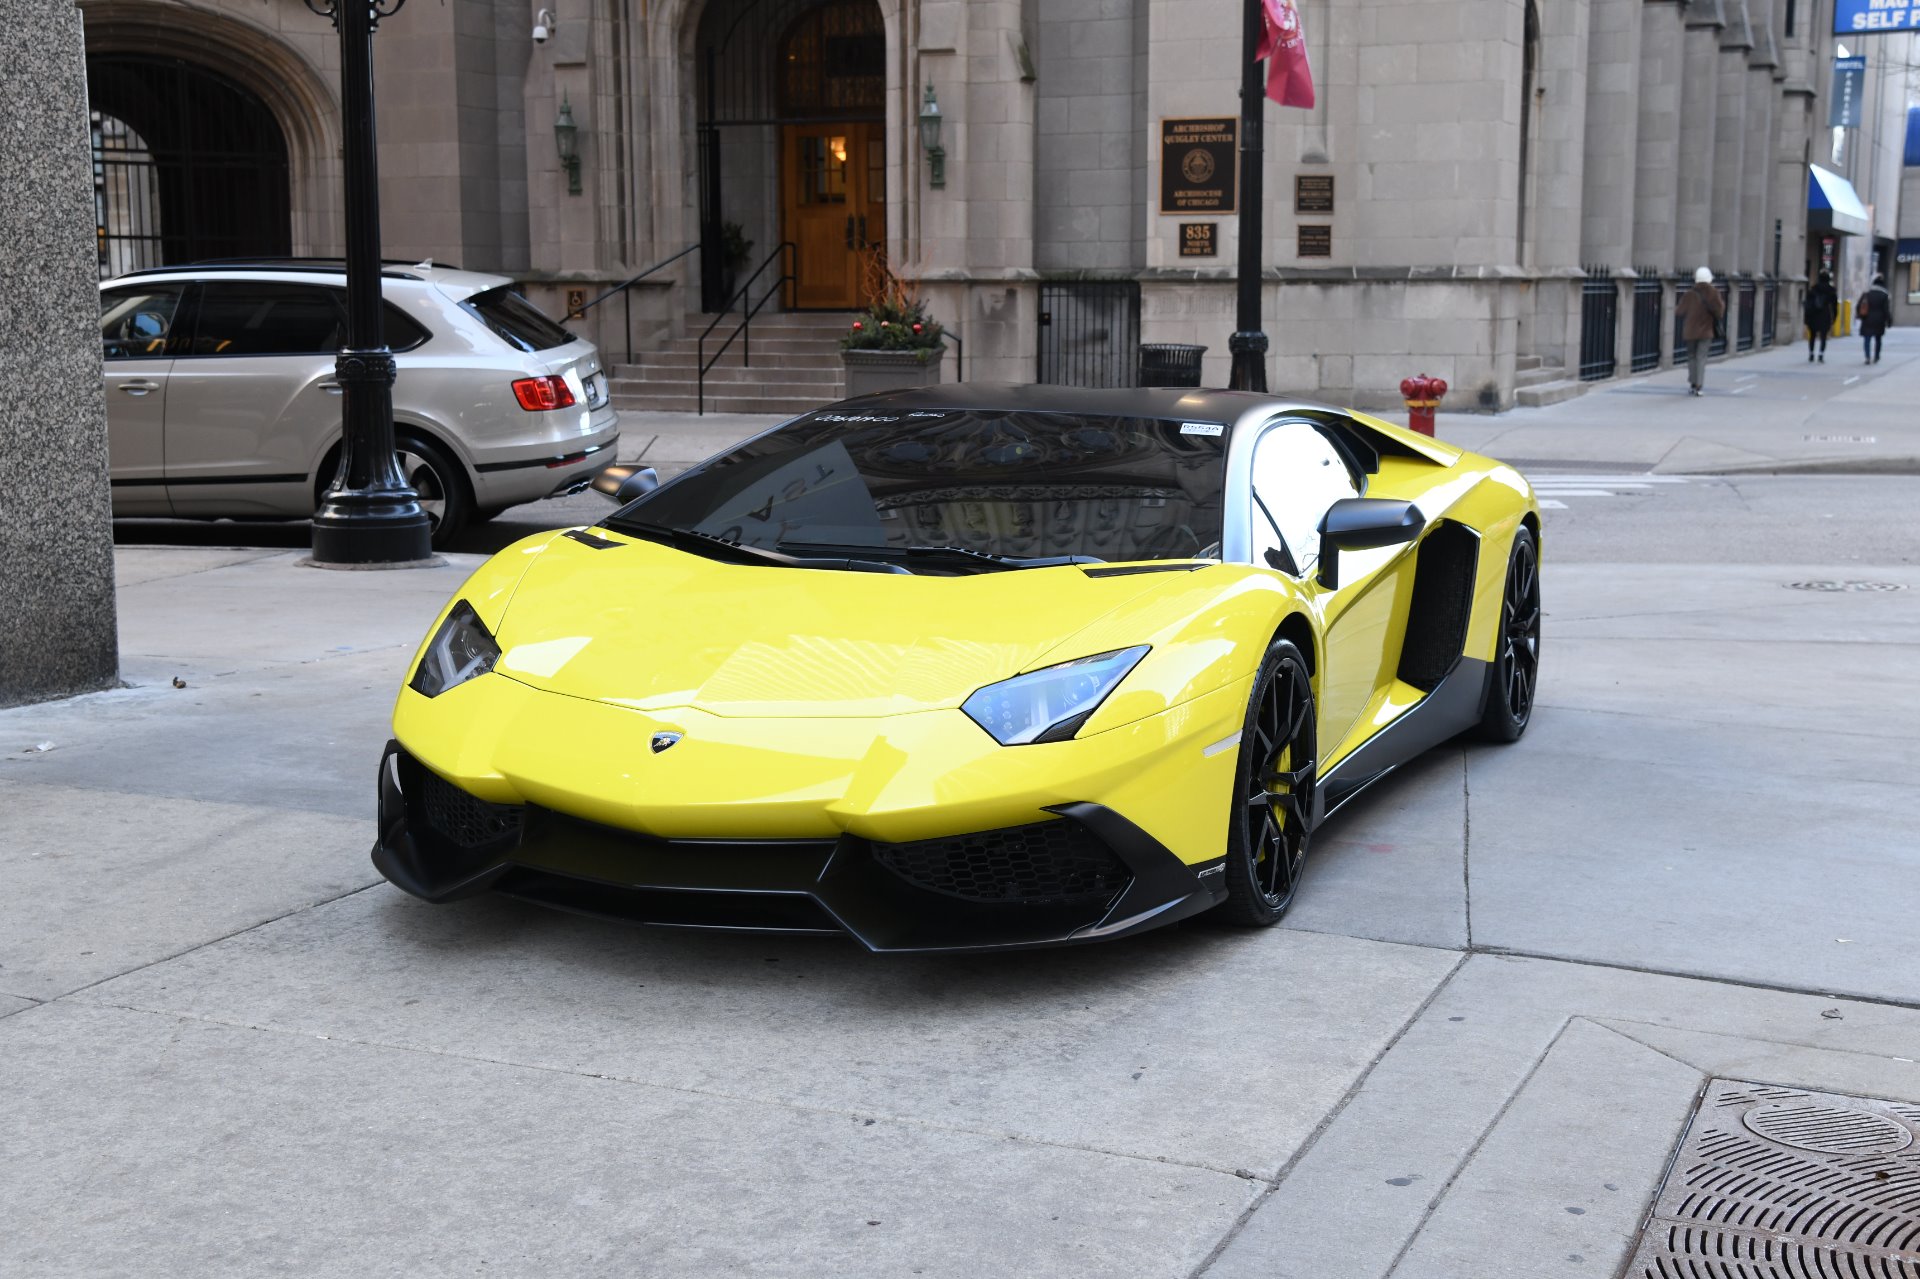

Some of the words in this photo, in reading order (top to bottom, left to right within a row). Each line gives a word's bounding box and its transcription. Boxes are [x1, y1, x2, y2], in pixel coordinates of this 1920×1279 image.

[1852, 11, 1906, 29] SELF
[1173, 124, 1226, 133] ARCHBISHOP
[1164, 135, 1199, 144] QUIGLEY
[1200, 134, 1233, 142] CENTER
[1186, 225, 1210, 240] 835
